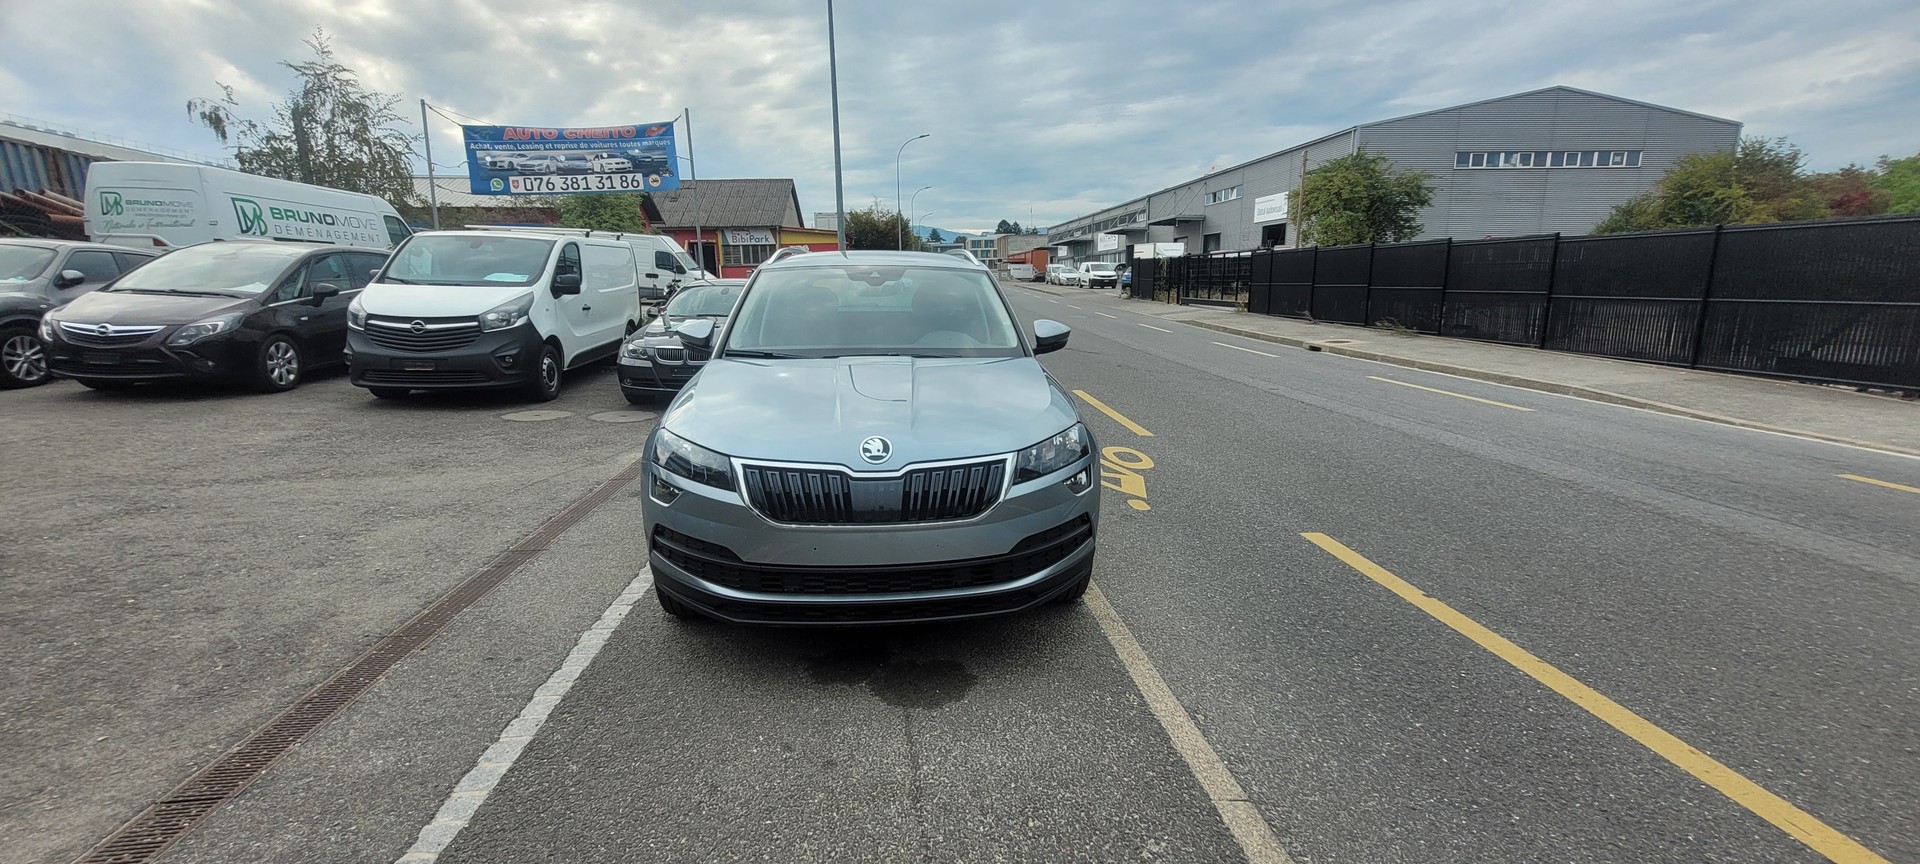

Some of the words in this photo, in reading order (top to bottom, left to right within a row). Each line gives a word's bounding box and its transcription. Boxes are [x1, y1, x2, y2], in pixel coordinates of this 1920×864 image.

[503, 127, 558, 141] AUTO
[470, 142, 493, 150] Achat,
[494, 143, 517, 151] vente,
[517, 142, 544, 151] Leasing
[554, 142, 578, 151] reprise
[590, 141, 618, 149] voitures
[642, 139, 671, 147] marques
[523, 177, 556, 191] 076
[560, 176, 592, 191] 381
[595, 175, 616, 189] 31
[620, 174, 640, 189] 86
[125, 200, 194, 208] BRUNOMOVE
[268, 206, 378, 231] BRUNOMOVE
[274, 223, 381, 243] DÉMÉNAGEMENT
[731, 234, 770, 243] BibiPark
